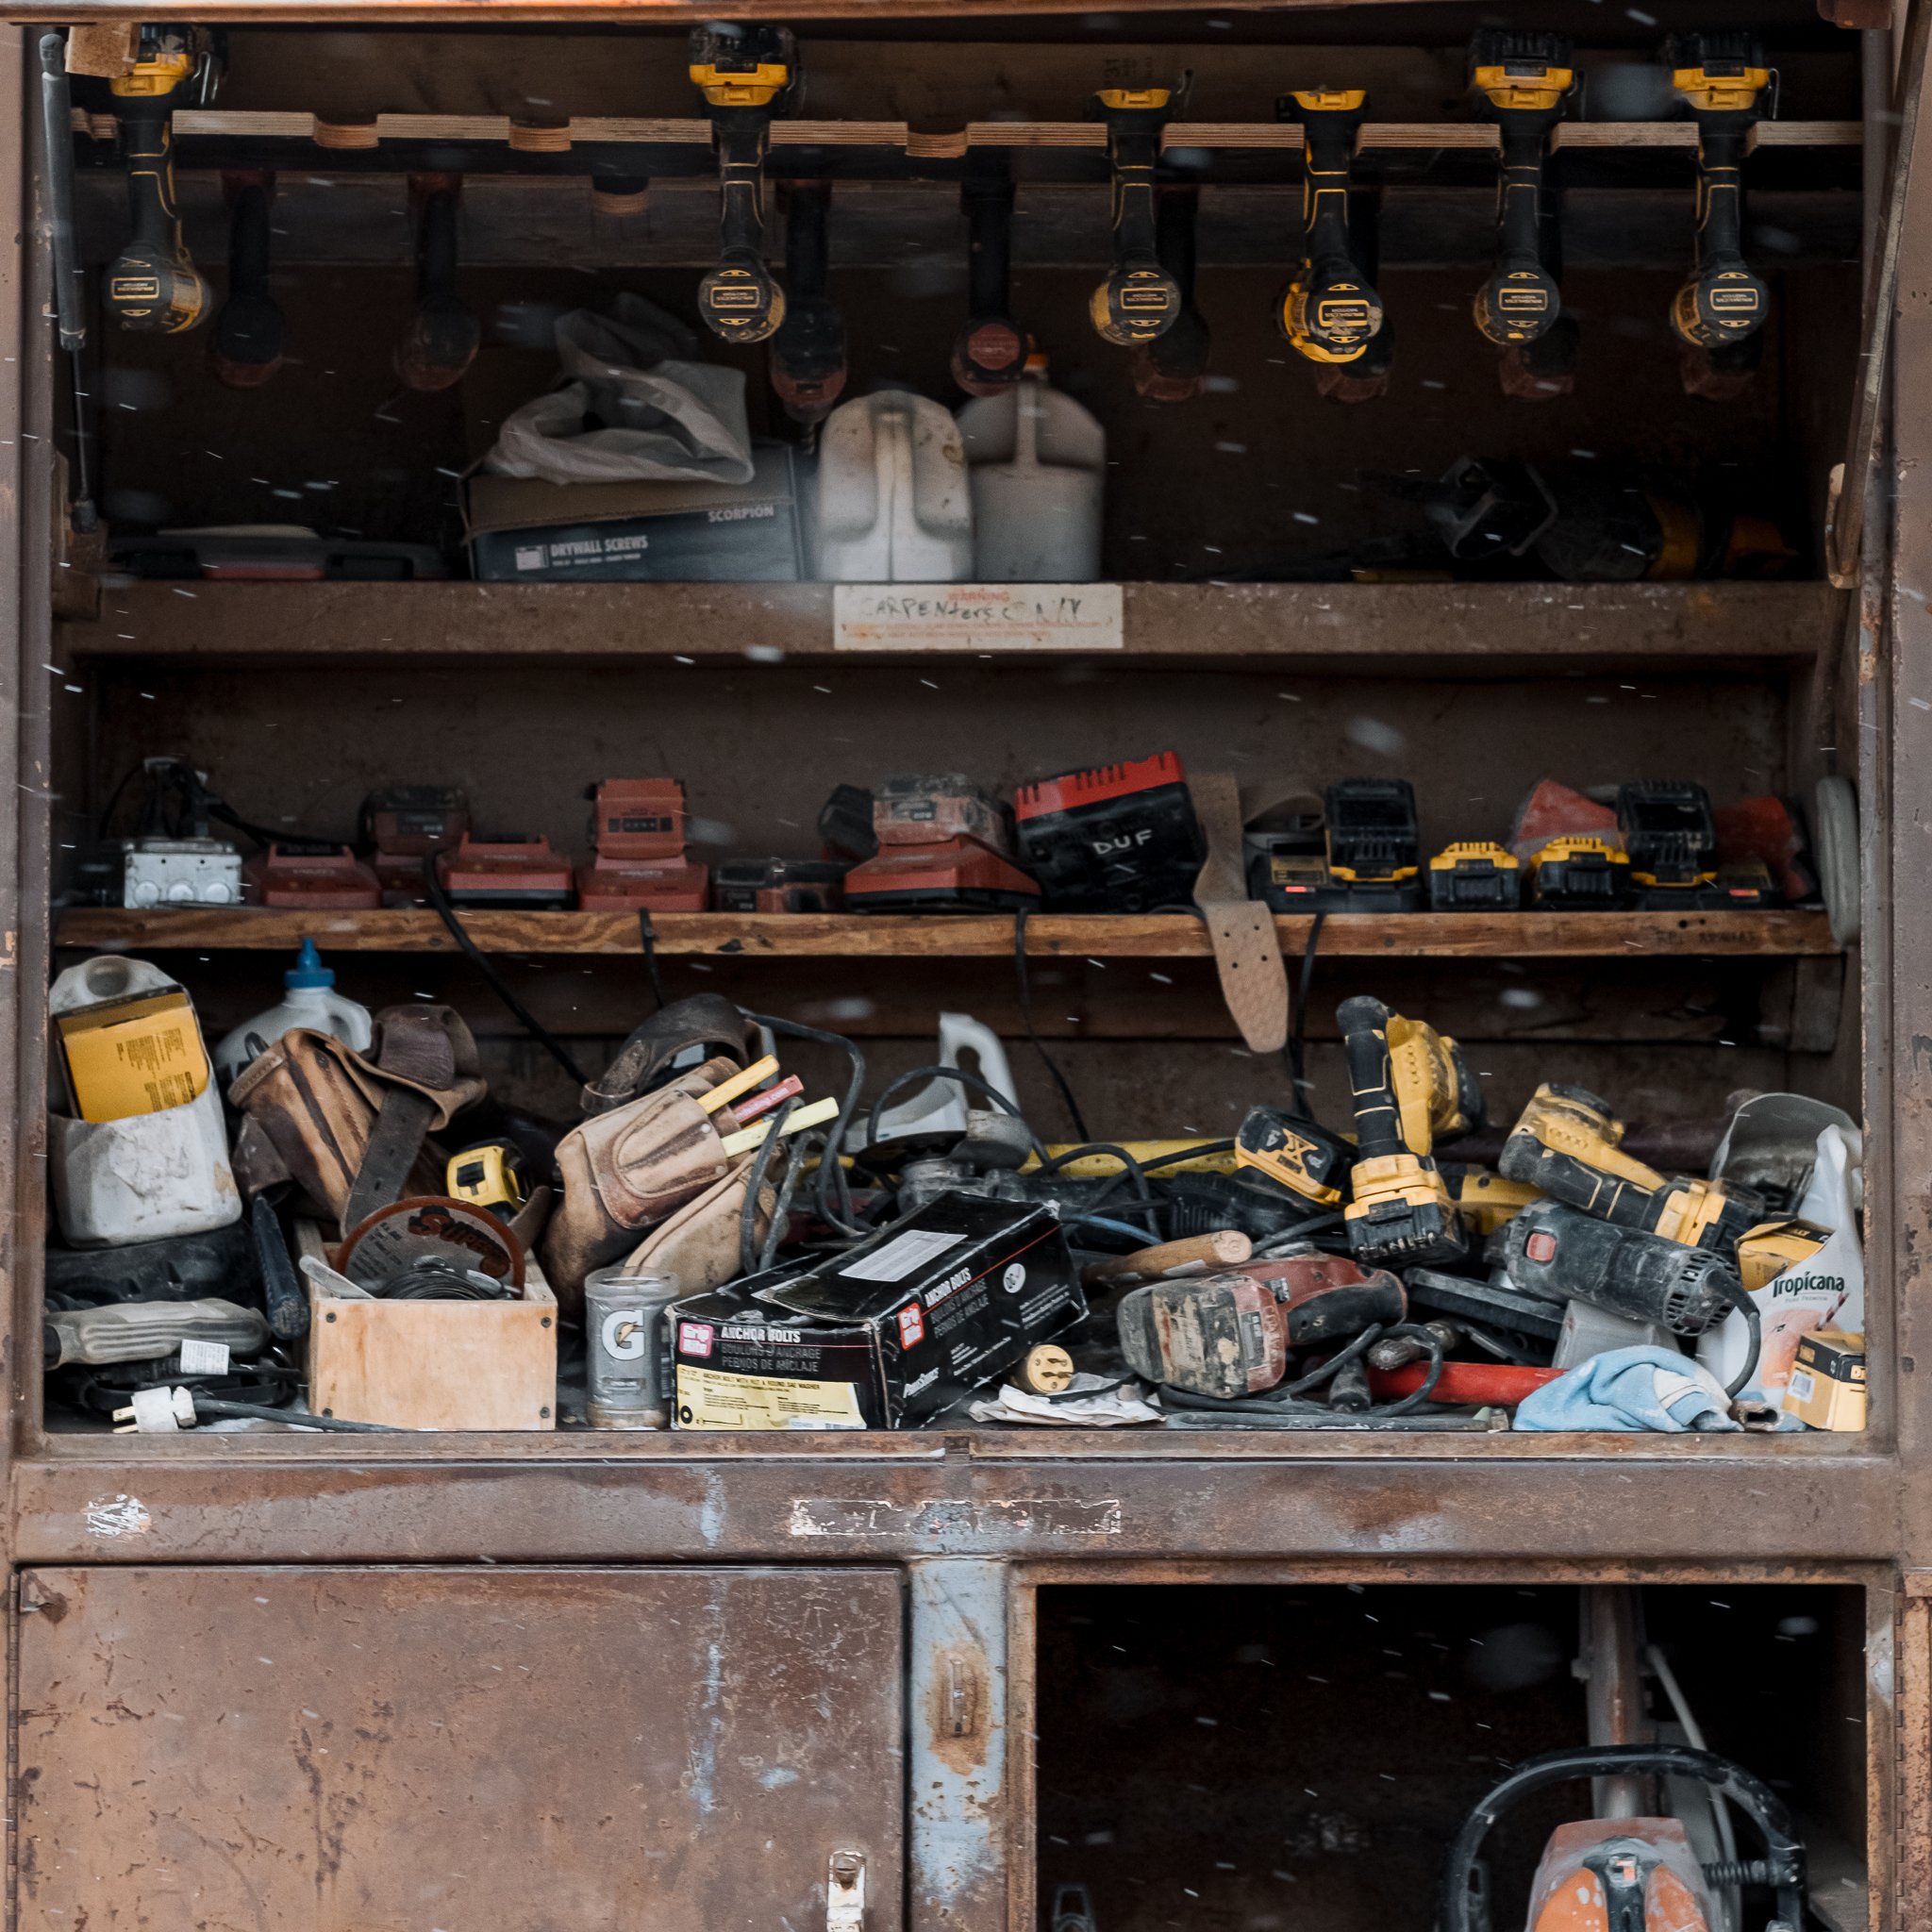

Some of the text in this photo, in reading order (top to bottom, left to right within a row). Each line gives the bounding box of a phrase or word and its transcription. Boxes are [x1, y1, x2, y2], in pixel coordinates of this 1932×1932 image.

[708, 505, 774, 523] SCORPION
[550, 535, 648, 558] DRYWALL SCREWS
[1092, 828, 1152, 855] DUF
[1773, 1271, 1845, 1298] Tropicana
[601, 1309, 645, 1360] G
[721, 1326, 801, 1343] ANCHOR BOLTS
